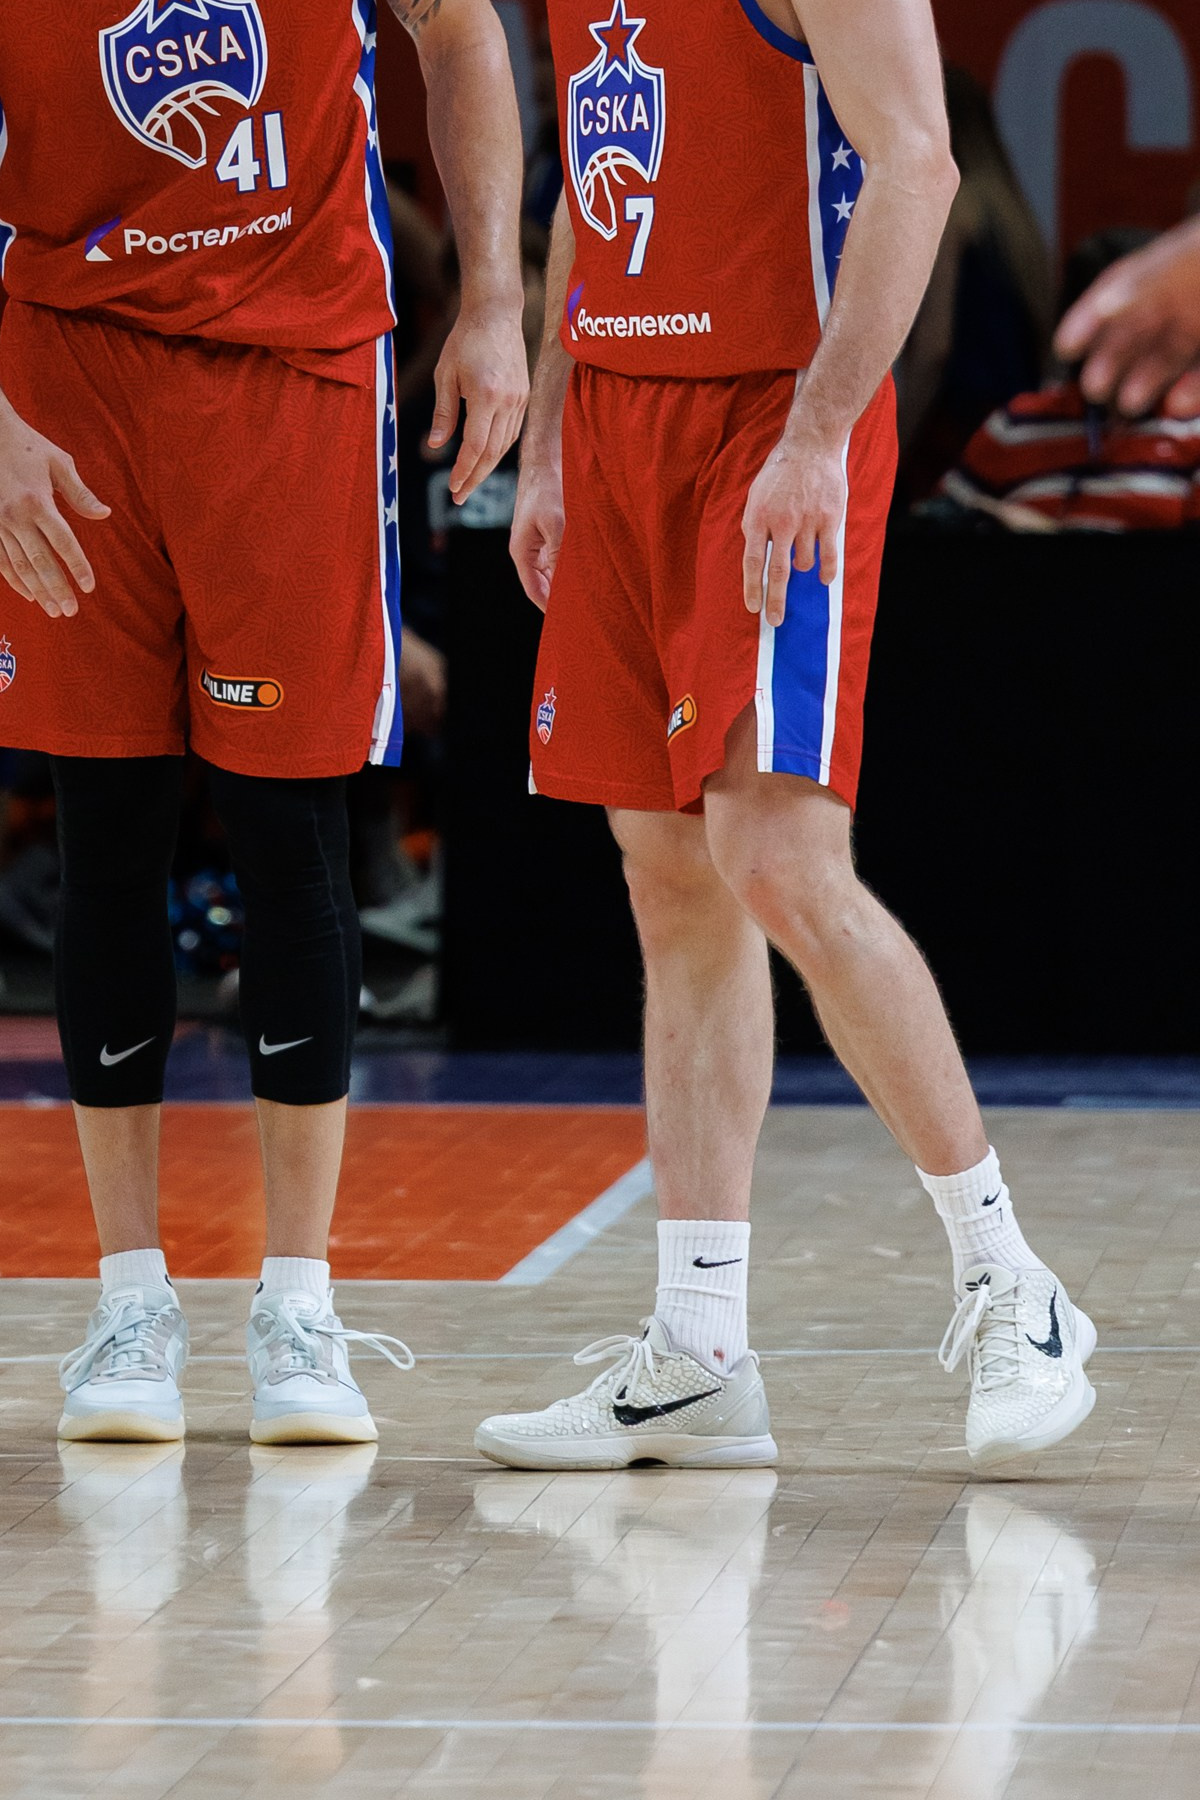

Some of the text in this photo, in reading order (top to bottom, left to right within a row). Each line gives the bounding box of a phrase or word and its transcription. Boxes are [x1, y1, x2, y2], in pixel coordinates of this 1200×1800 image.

[125, 24, 247, 85] CSKA
[579, 93, 650, 136] CSKA
[215, 111, 289, 193] 41
[624, 196, 655, 276] 7
[577, 308, 712, 338] Ростелеком
